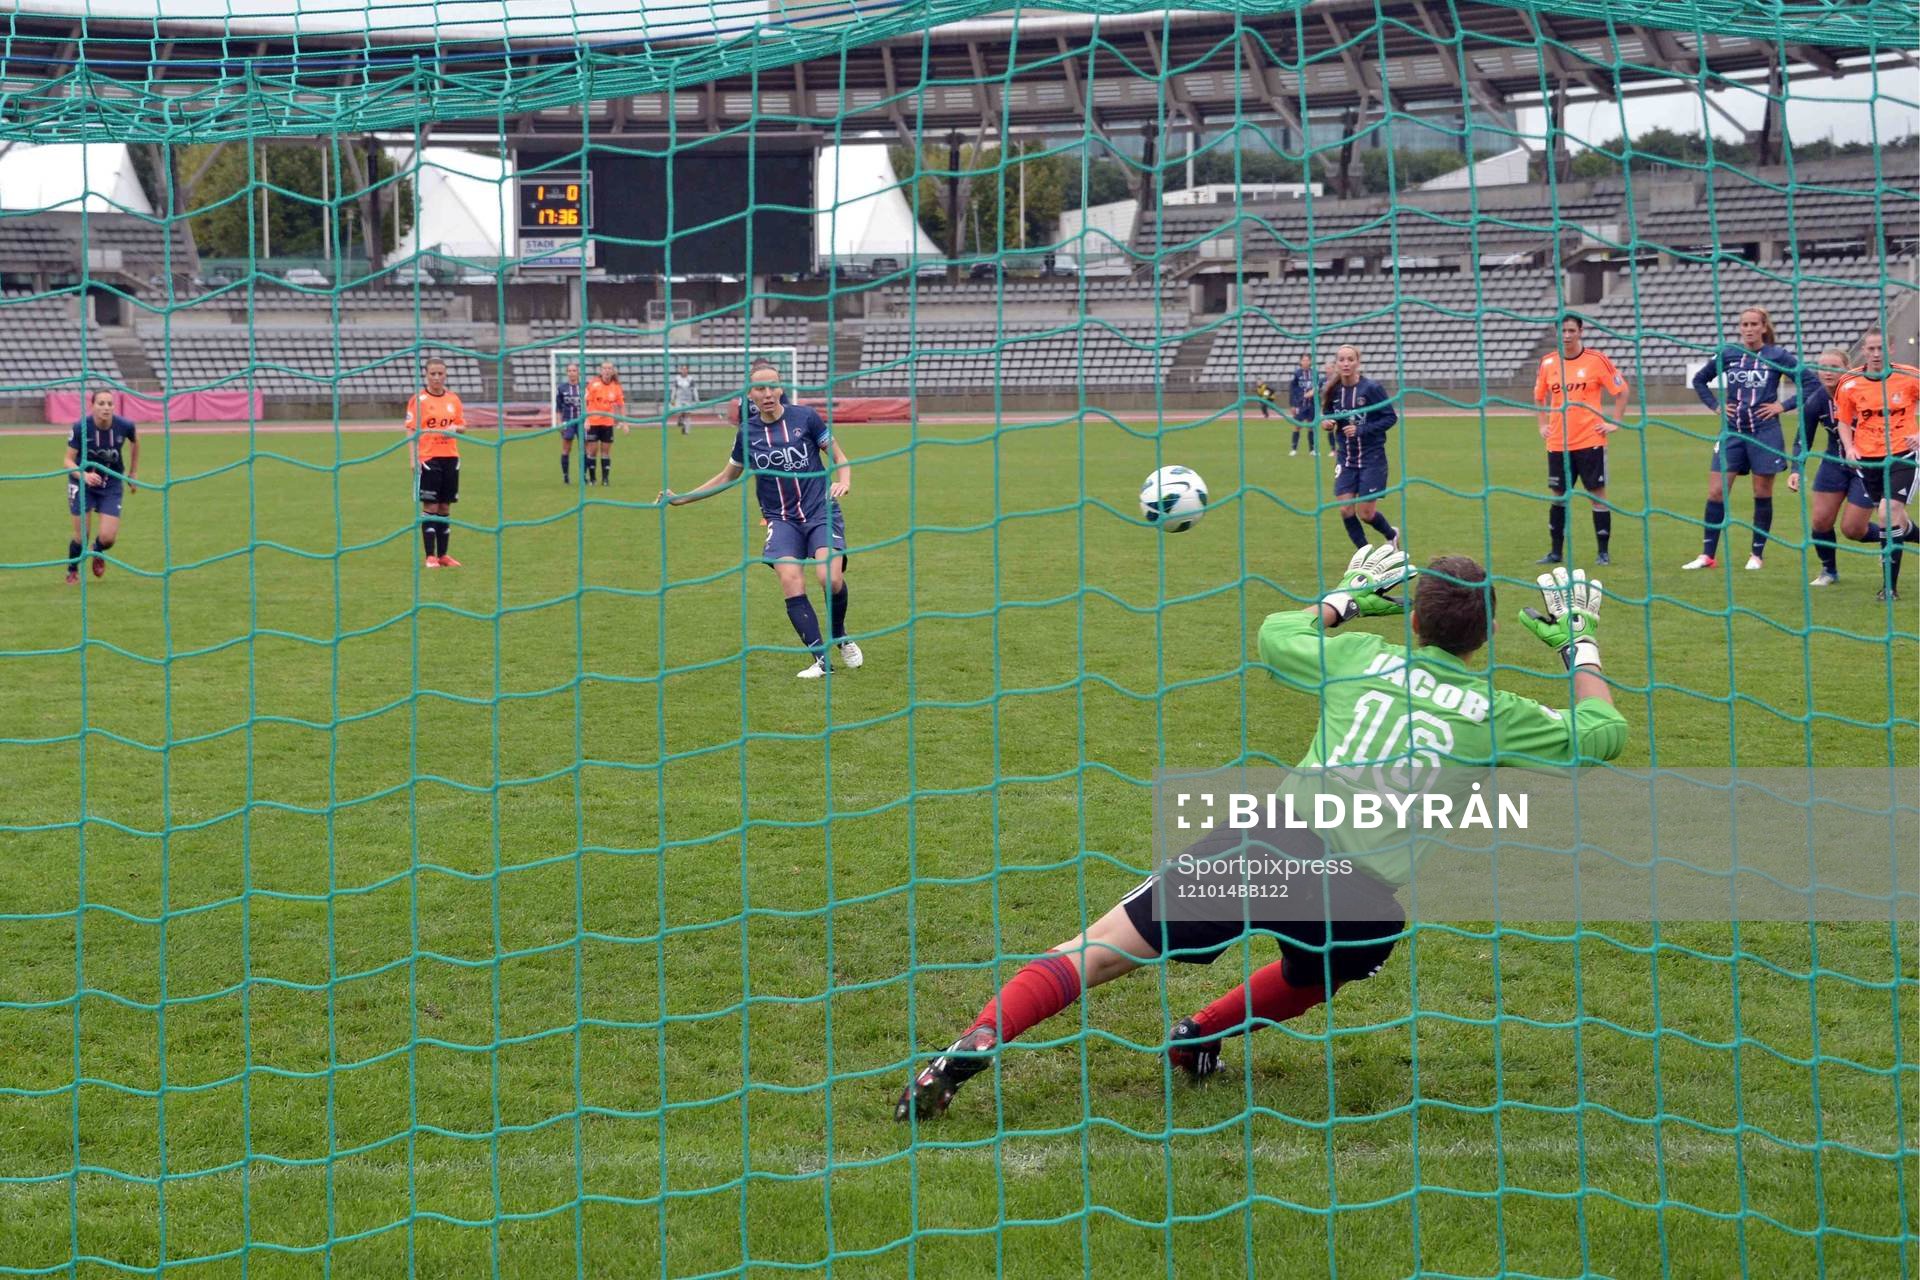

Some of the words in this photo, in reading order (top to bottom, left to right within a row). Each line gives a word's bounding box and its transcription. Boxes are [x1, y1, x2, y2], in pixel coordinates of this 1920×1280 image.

[537, 185, 545, 201] 1
[566, 185, 579, 201] 0
[538, 208, 578, 225] 17:36
[783, 457, 809, 472] SPORT
[1362, 652, 1490, 723] JACOB
